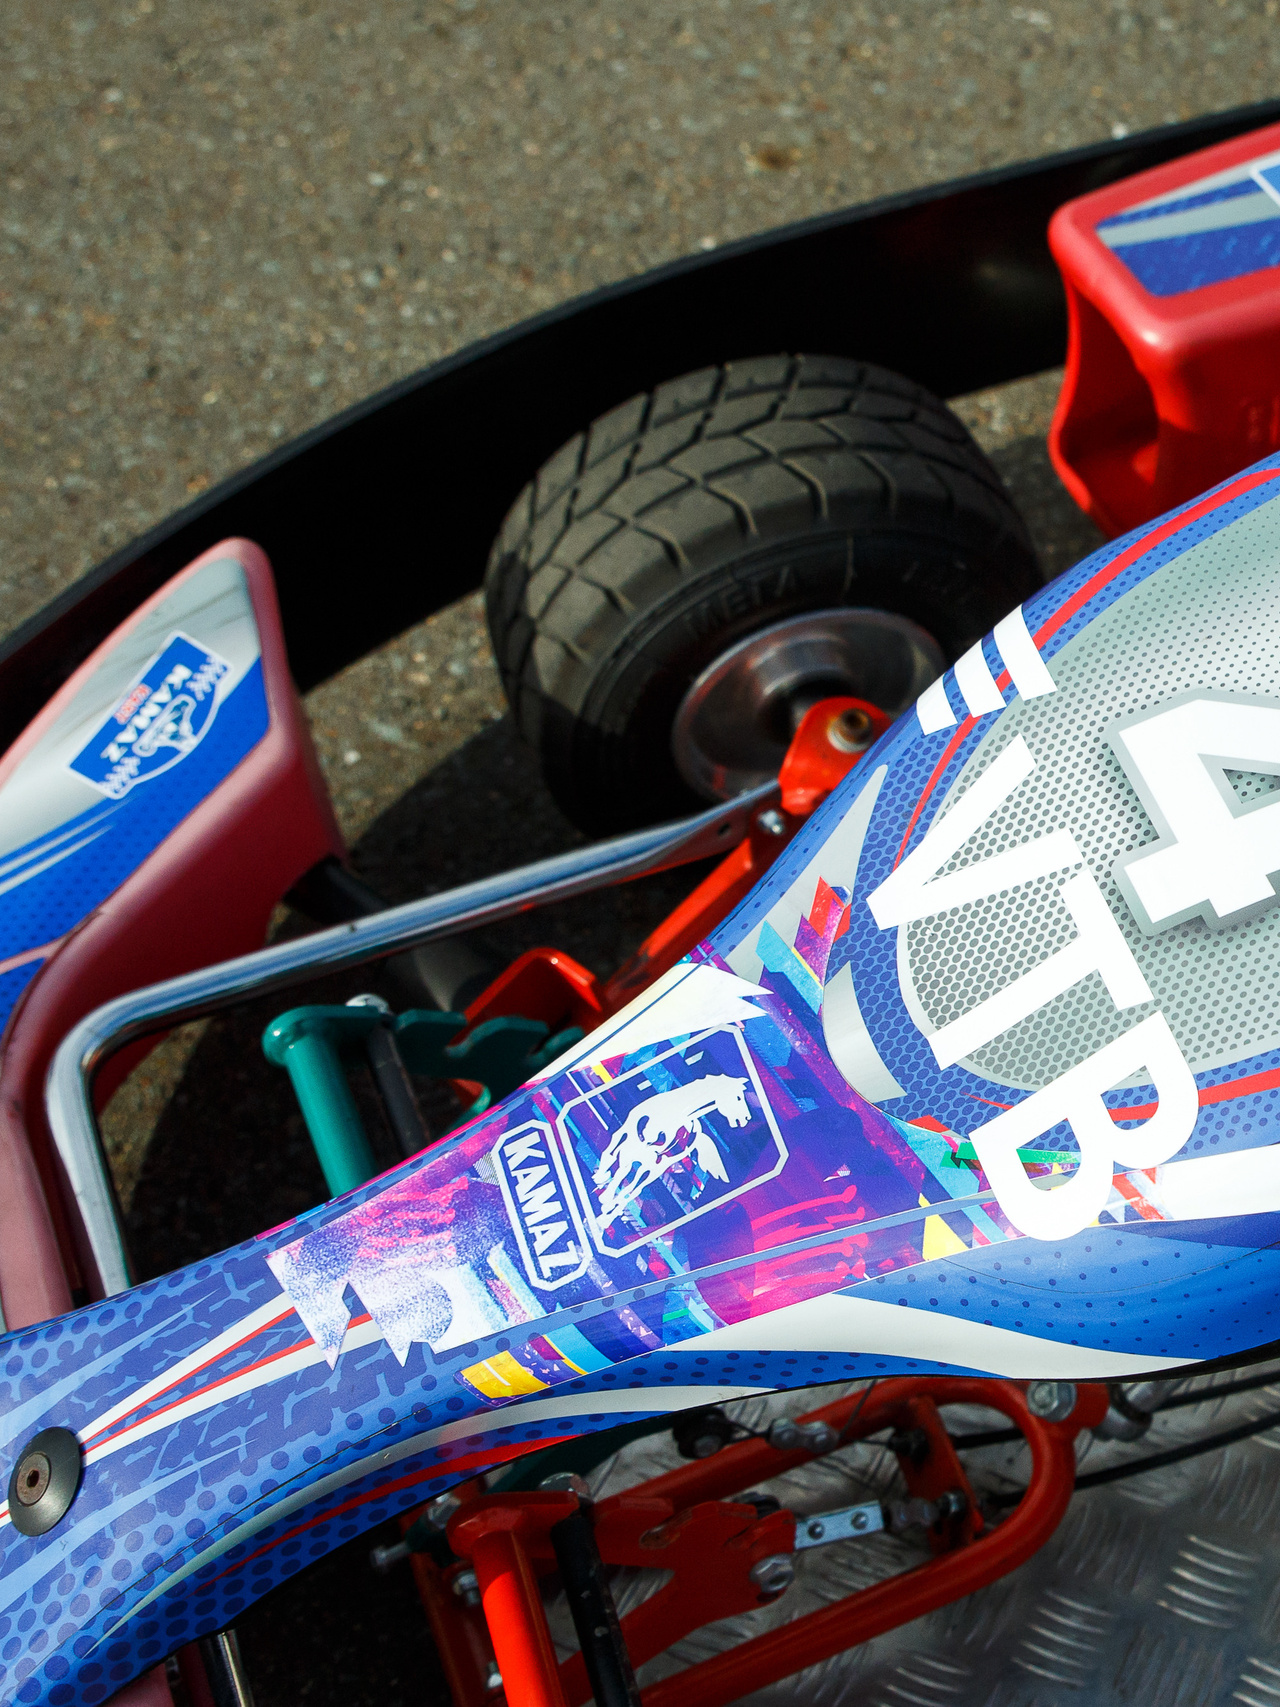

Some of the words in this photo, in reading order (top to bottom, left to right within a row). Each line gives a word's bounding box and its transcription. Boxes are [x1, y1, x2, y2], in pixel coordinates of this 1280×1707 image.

[101, 663, 193, 763] KAMAZ
[866, 733, 1199, 1241] VTB
[503, 1131, 581, 1278] KAMAZ
